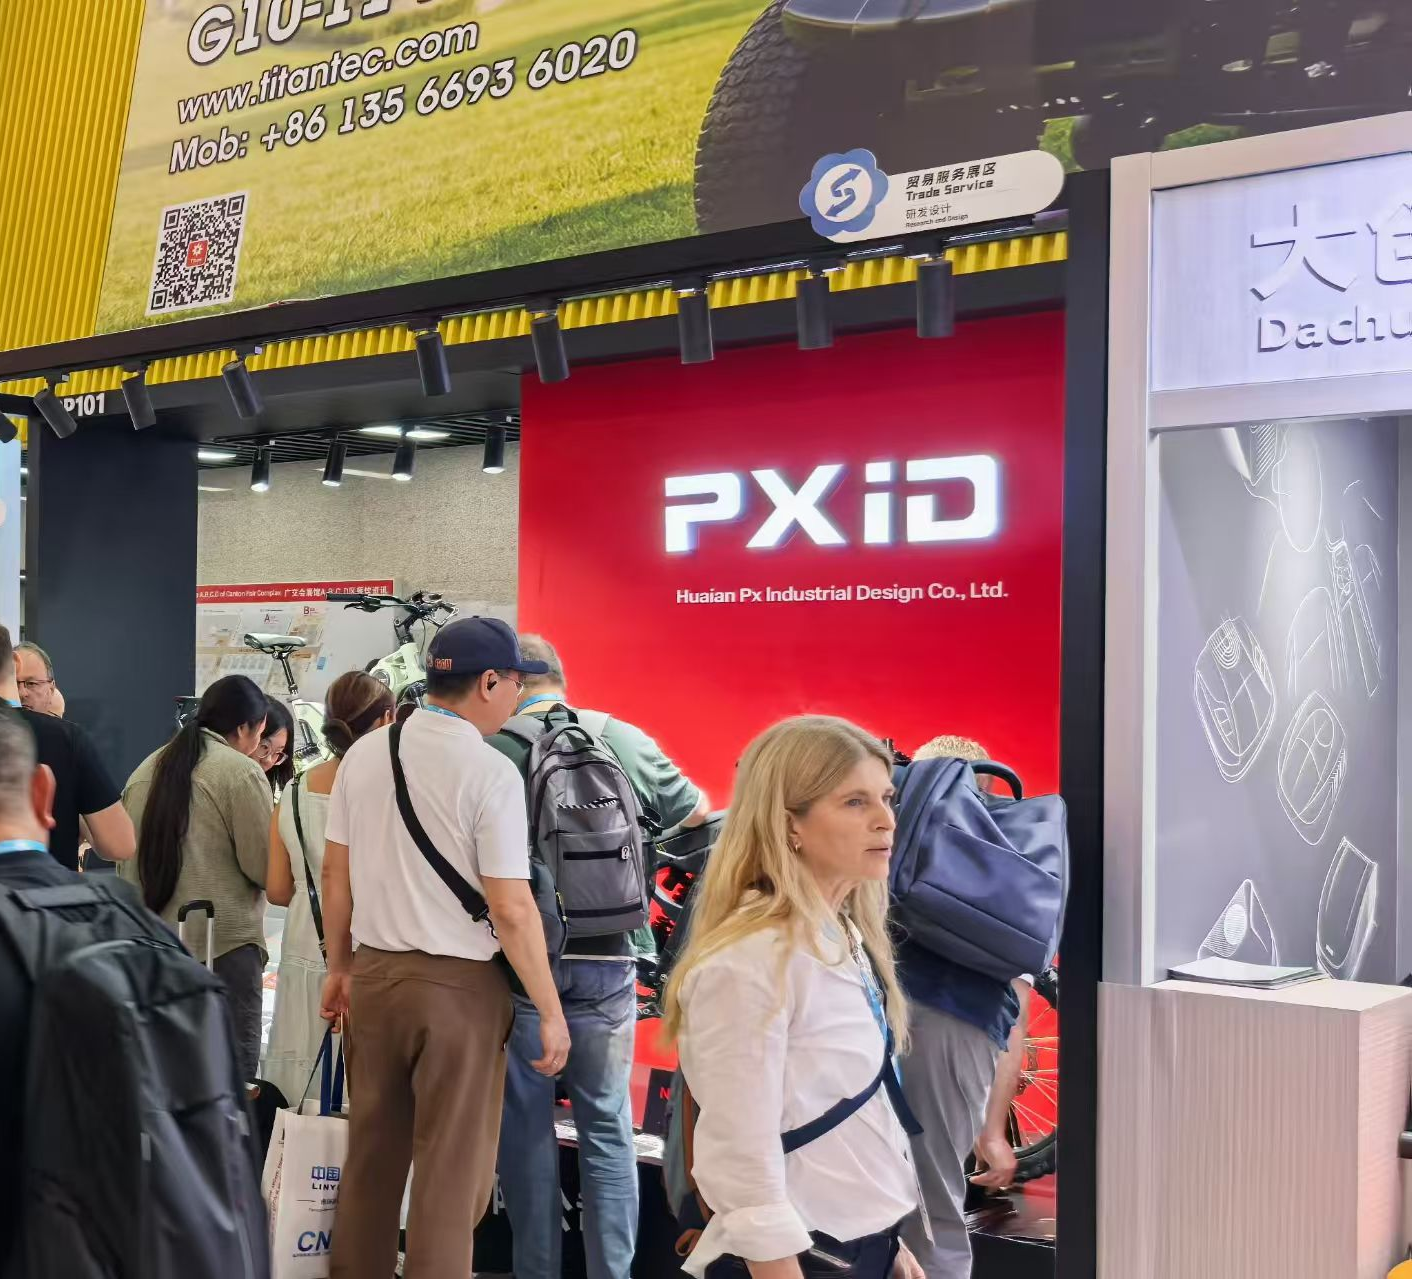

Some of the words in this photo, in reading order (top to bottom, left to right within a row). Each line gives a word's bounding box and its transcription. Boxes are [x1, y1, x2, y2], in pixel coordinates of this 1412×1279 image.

[177, 20, 480, 124] www.titantec.com
[168, 128, 250, 174] Mob:
[260, 104, 327, 152] +86
[338, 85, 405, 136] 135
[415, 59, 516, 117] 6693
[526, 28, 637, 89] 6020
[906, 161, 996, 190] 贸易服务展区
[906, 187, 940, 201] Trade
[944, 179, 994, 195] Service
[906, 203, 952, 220] 研发设计
[60, 392, 105, 417] P101
[676, 588, 736, 604] Huaian
[740, 587, 762, 603] Px
[766, 585, 852, 602] Industrial
[857, 583, 925, 604] Design
[928, 582, 966, 601] Co.,
[970, 581, 1008, 599] Ltd.
